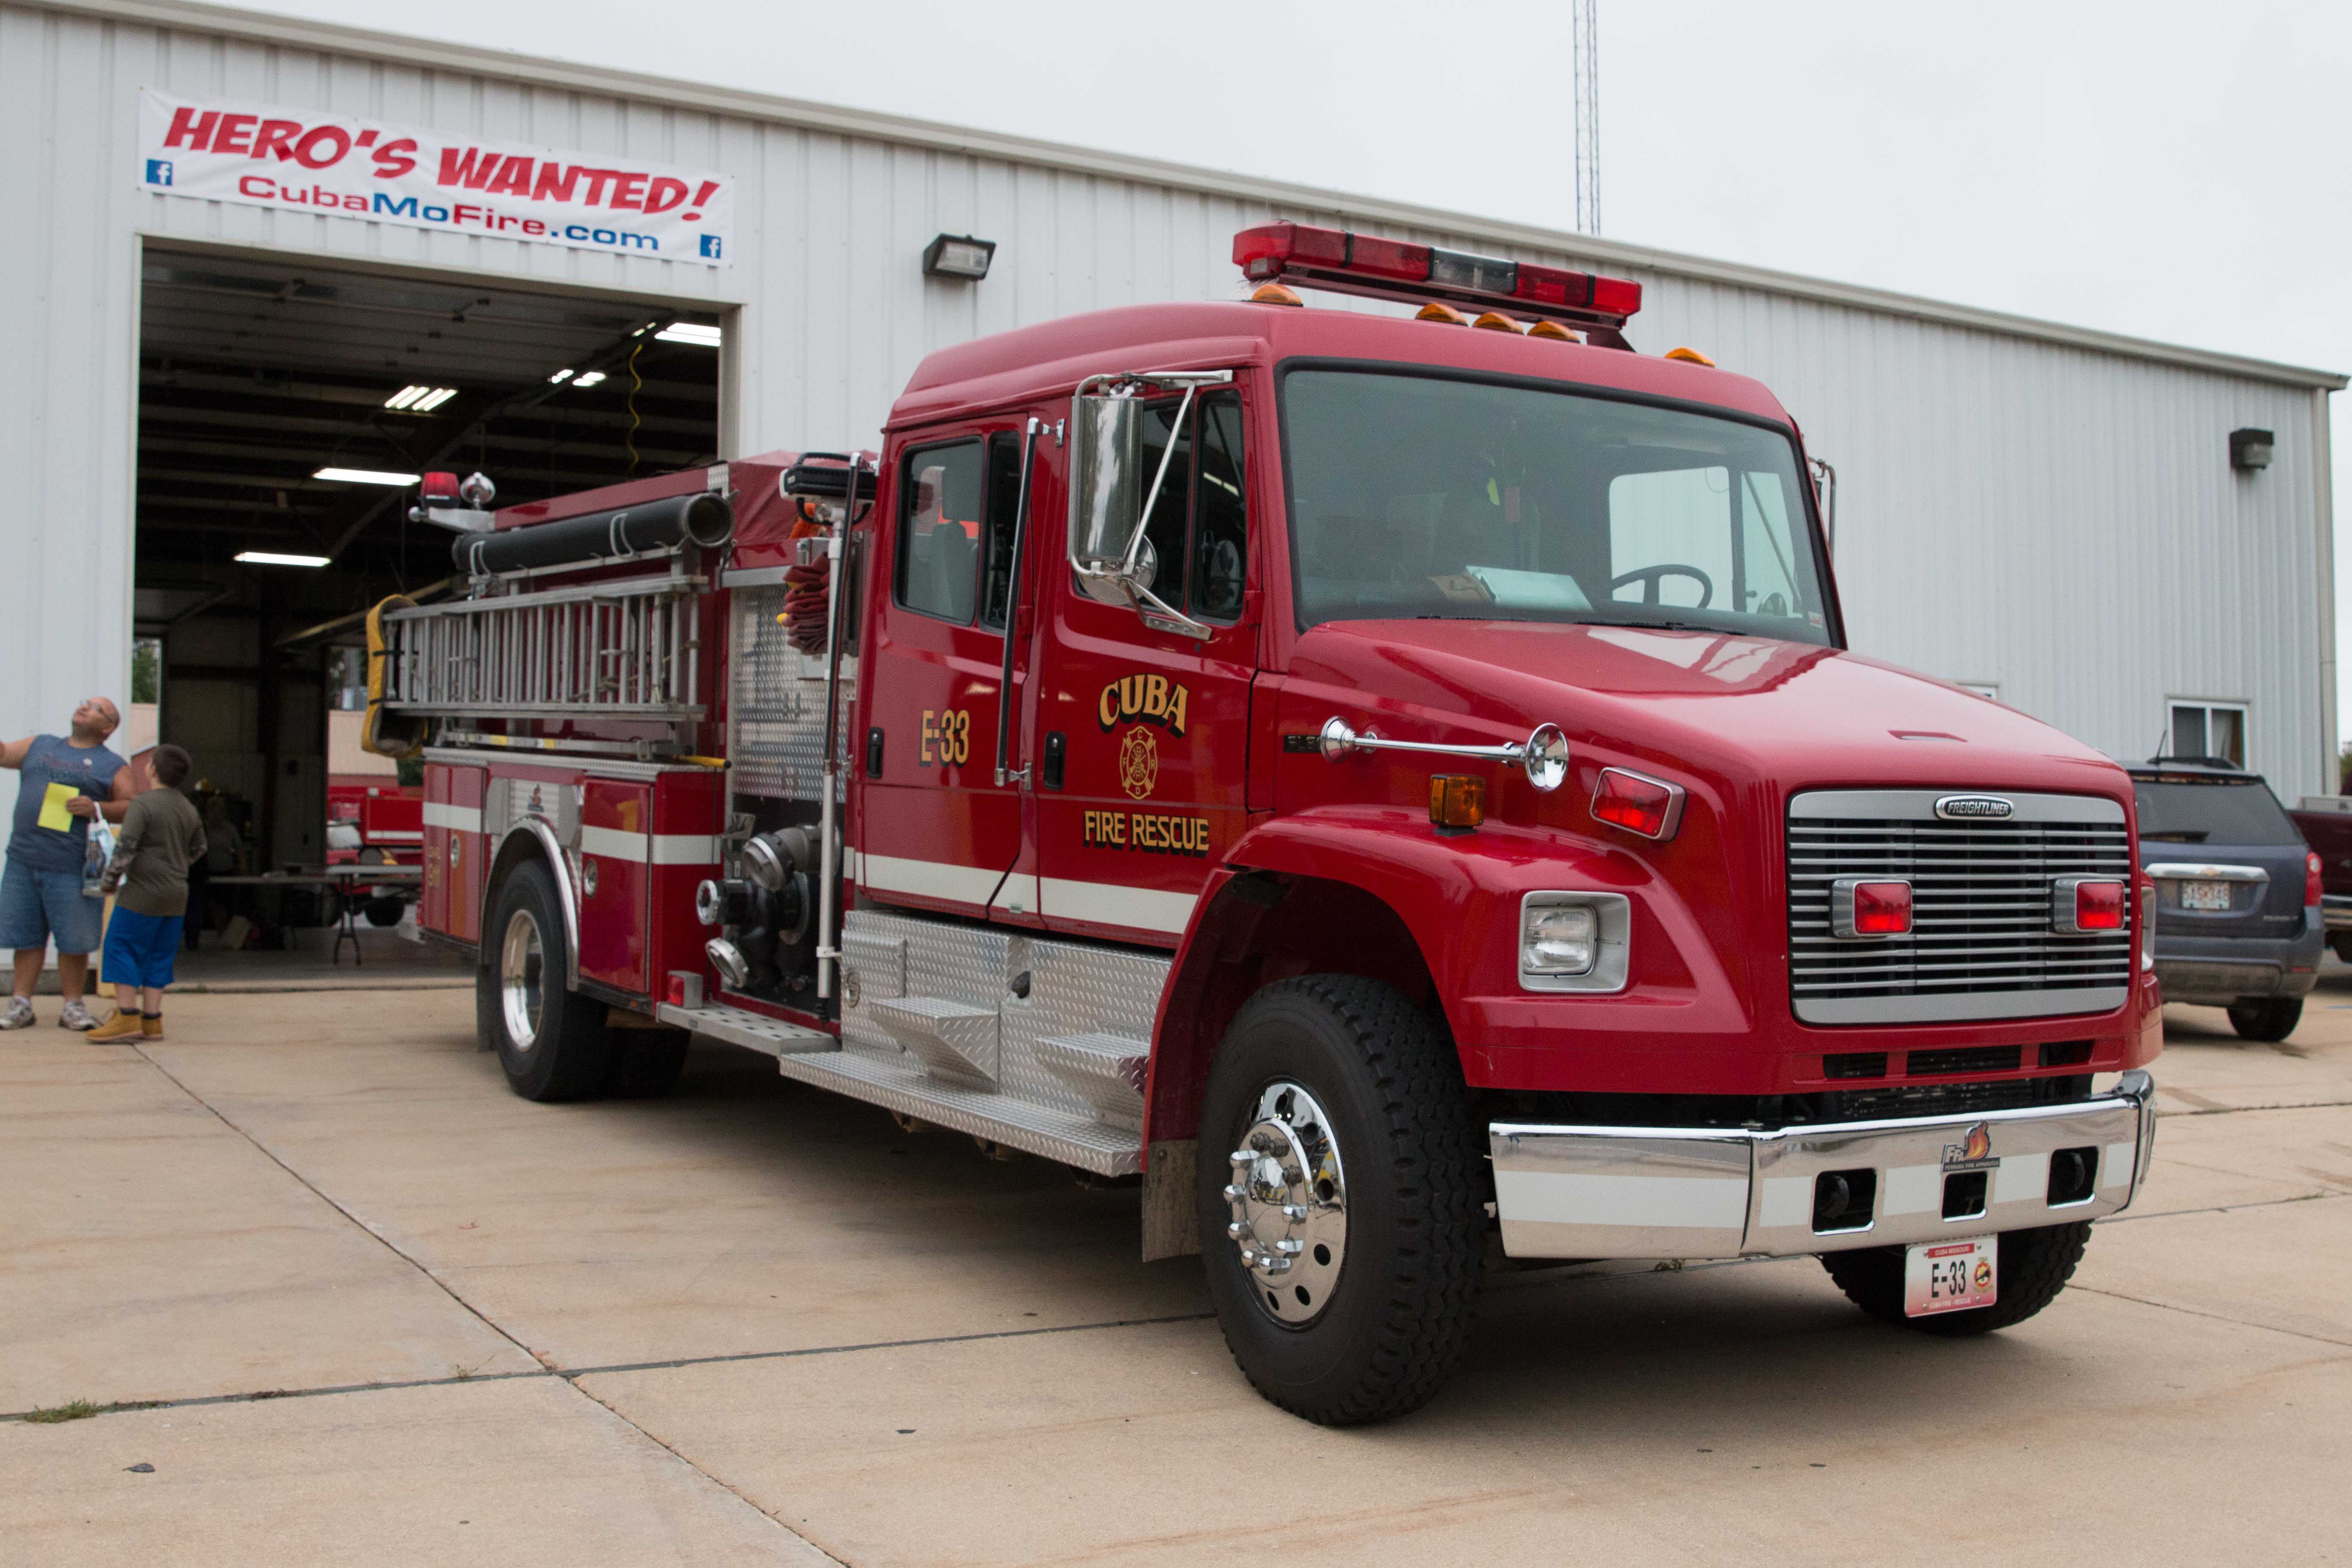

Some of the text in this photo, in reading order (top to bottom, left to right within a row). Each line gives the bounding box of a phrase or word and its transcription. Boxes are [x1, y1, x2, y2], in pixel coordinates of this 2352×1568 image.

[163, 107, 720, 230] HERO'S WANTED!
[239, 176, 658, 251] CubaMoFire.com
[1099, 674, 1188, 736] CUBA
[921, 709, 970, 764] E-33
[1084, 810, 1210, 851] FIRE RESCUE
[1947, 801, 2009, 815] FREIGHTLINER
[1932, 1260, 1966, 1298] E-33
